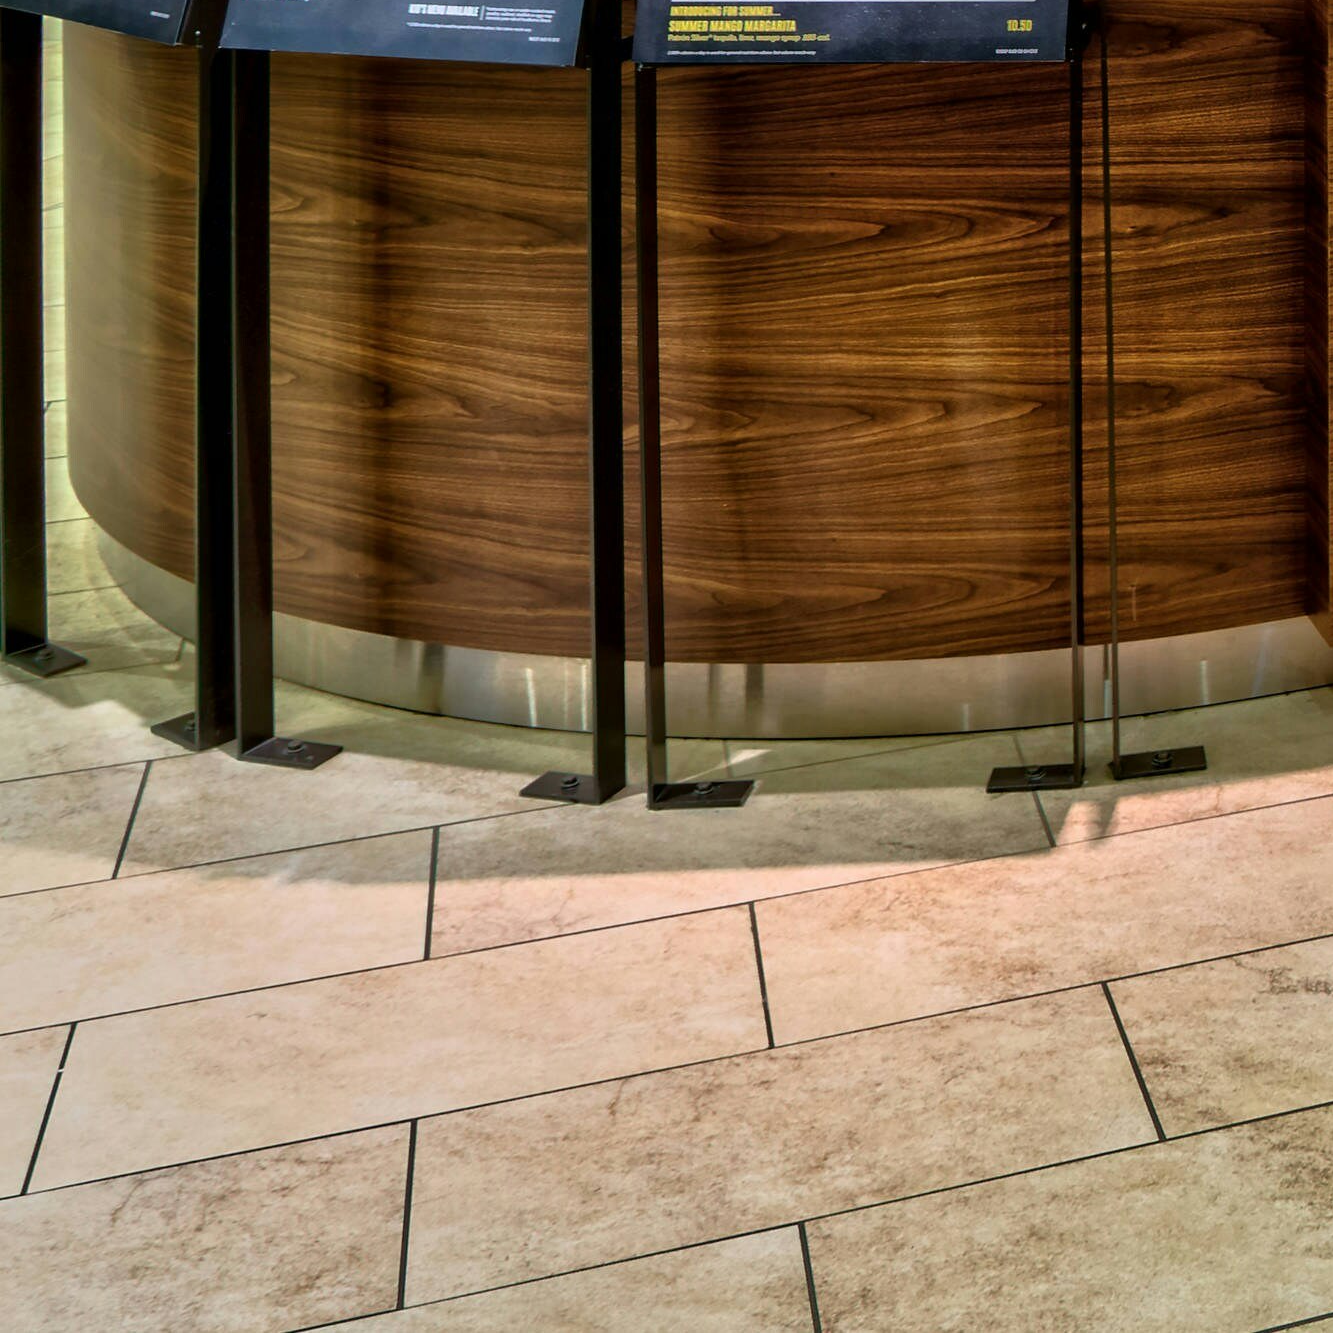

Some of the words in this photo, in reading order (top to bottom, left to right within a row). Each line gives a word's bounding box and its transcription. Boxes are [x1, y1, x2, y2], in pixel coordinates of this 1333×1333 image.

[668, 20, 708, 32] SUMMER
[710, 20, 742, 32] MANGO
[744, 20, 796, 32] MARGARITA
